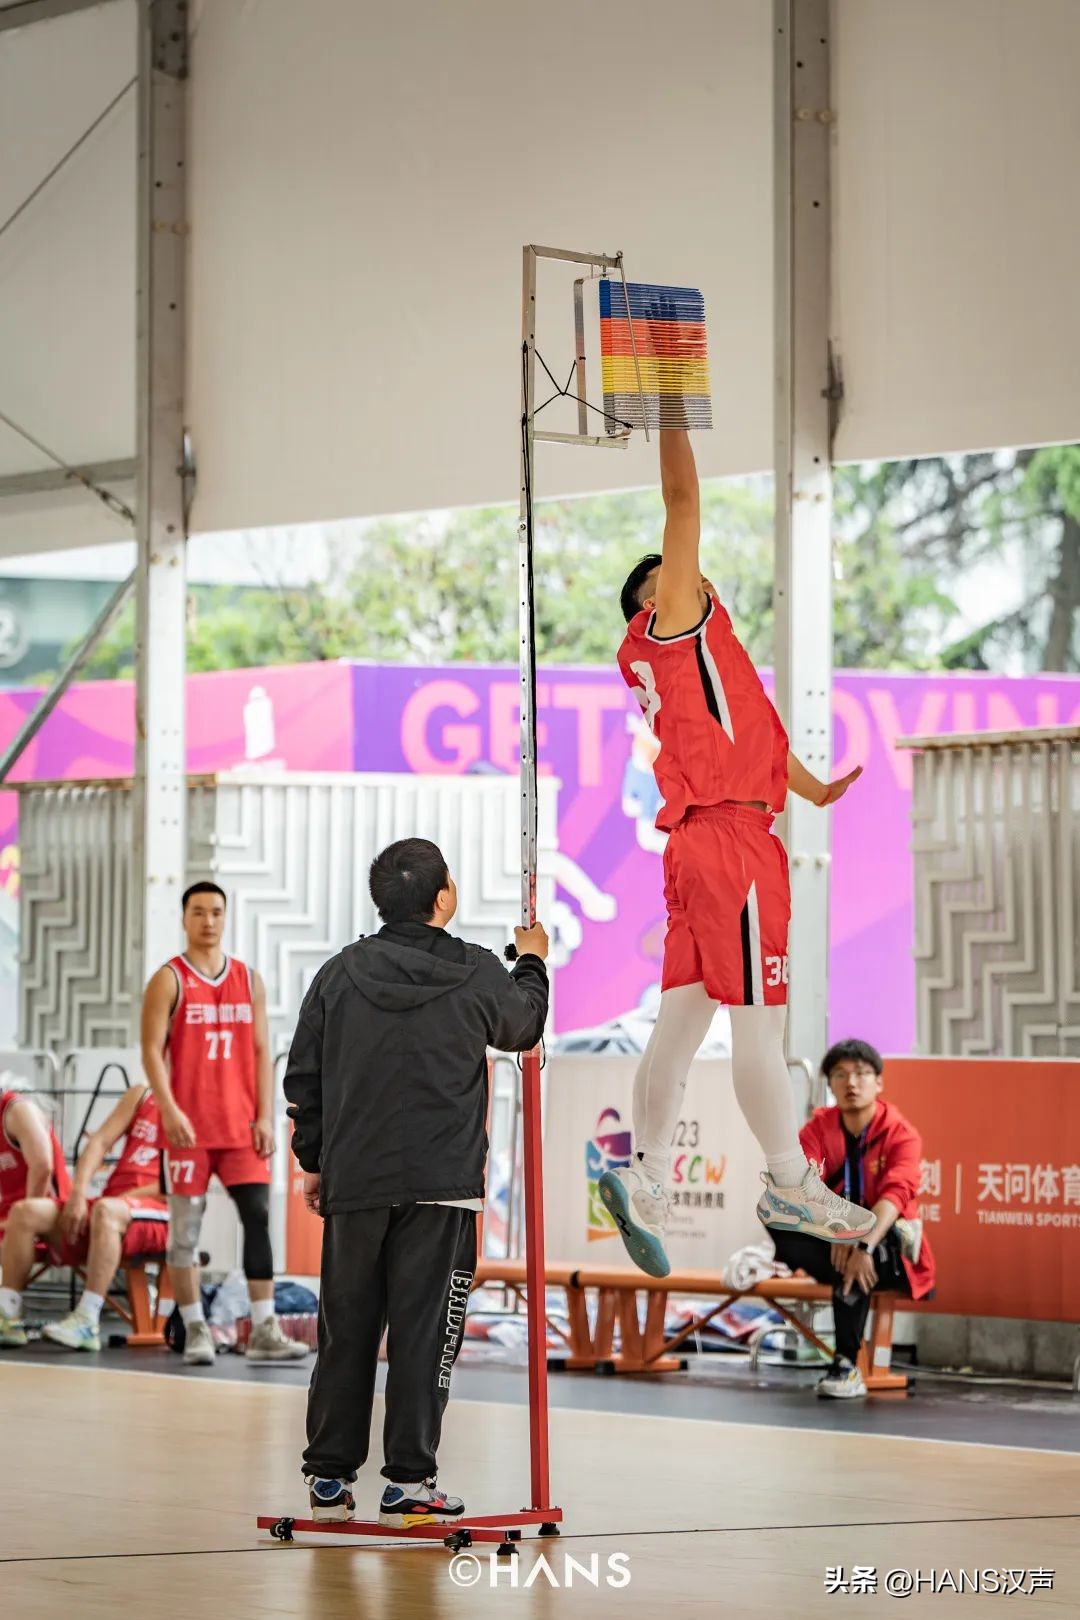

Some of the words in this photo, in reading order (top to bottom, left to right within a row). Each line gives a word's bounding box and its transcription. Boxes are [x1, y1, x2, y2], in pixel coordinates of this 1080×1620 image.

[401, 680, 628, 788] GET
[205, 1031, 233, 1060] 77
[170, 1160, 195, 1184] 77
[977, 1163, 1080, 1206] 天问体育
[977, 1209, 1033, 1226] TIANWEN
